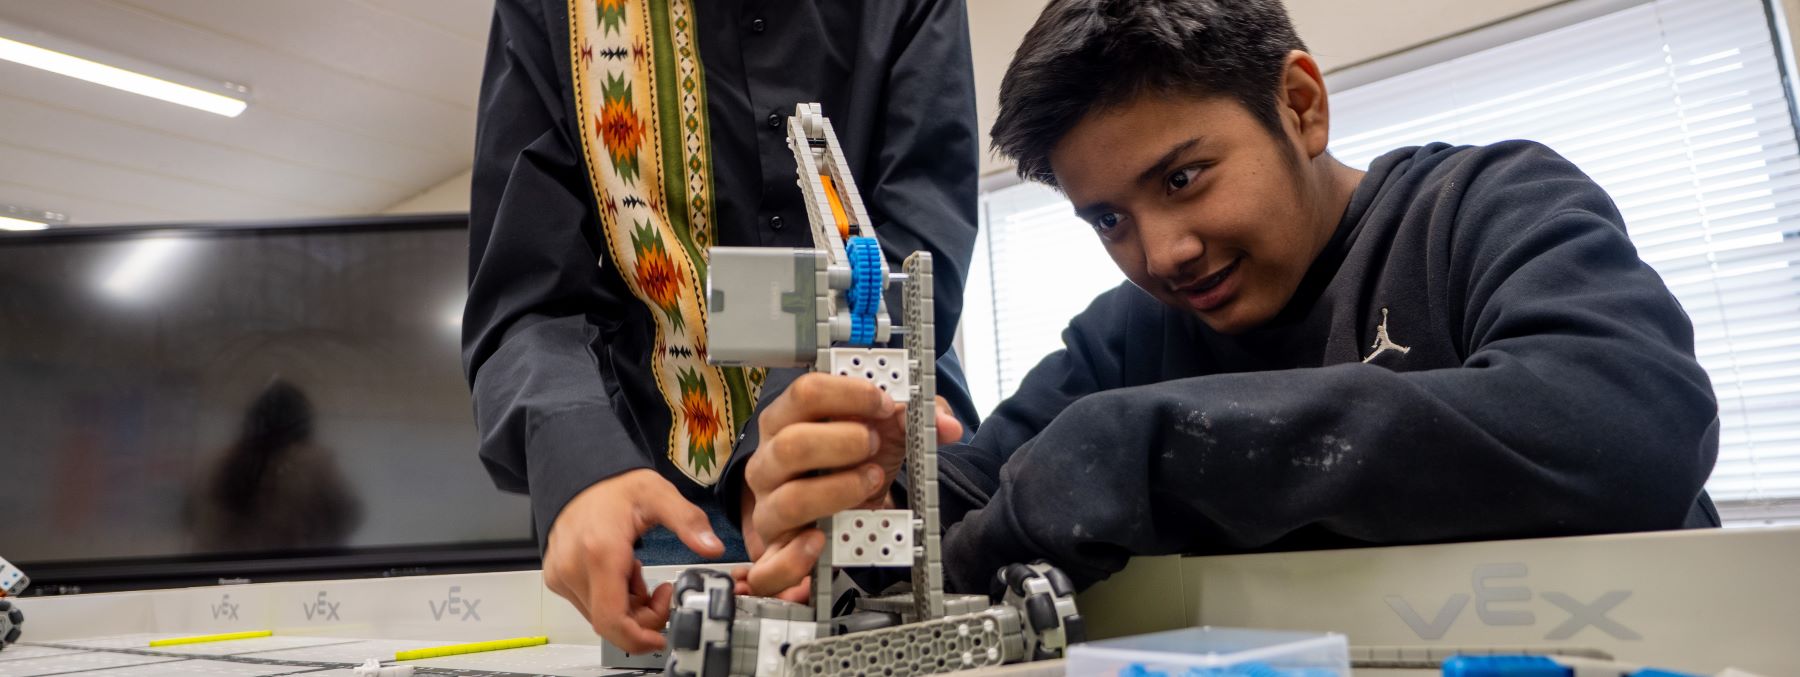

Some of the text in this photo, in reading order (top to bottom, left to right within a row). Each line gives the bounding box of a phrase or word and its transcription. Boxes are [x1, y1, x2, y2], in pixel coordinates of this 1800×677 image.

[211, 594, 239, 620] VEX
[303, 591, 340, 620] VEX
[428, 586, 481, 621] VEX
[1383, 563, 1643, 640] VEX
